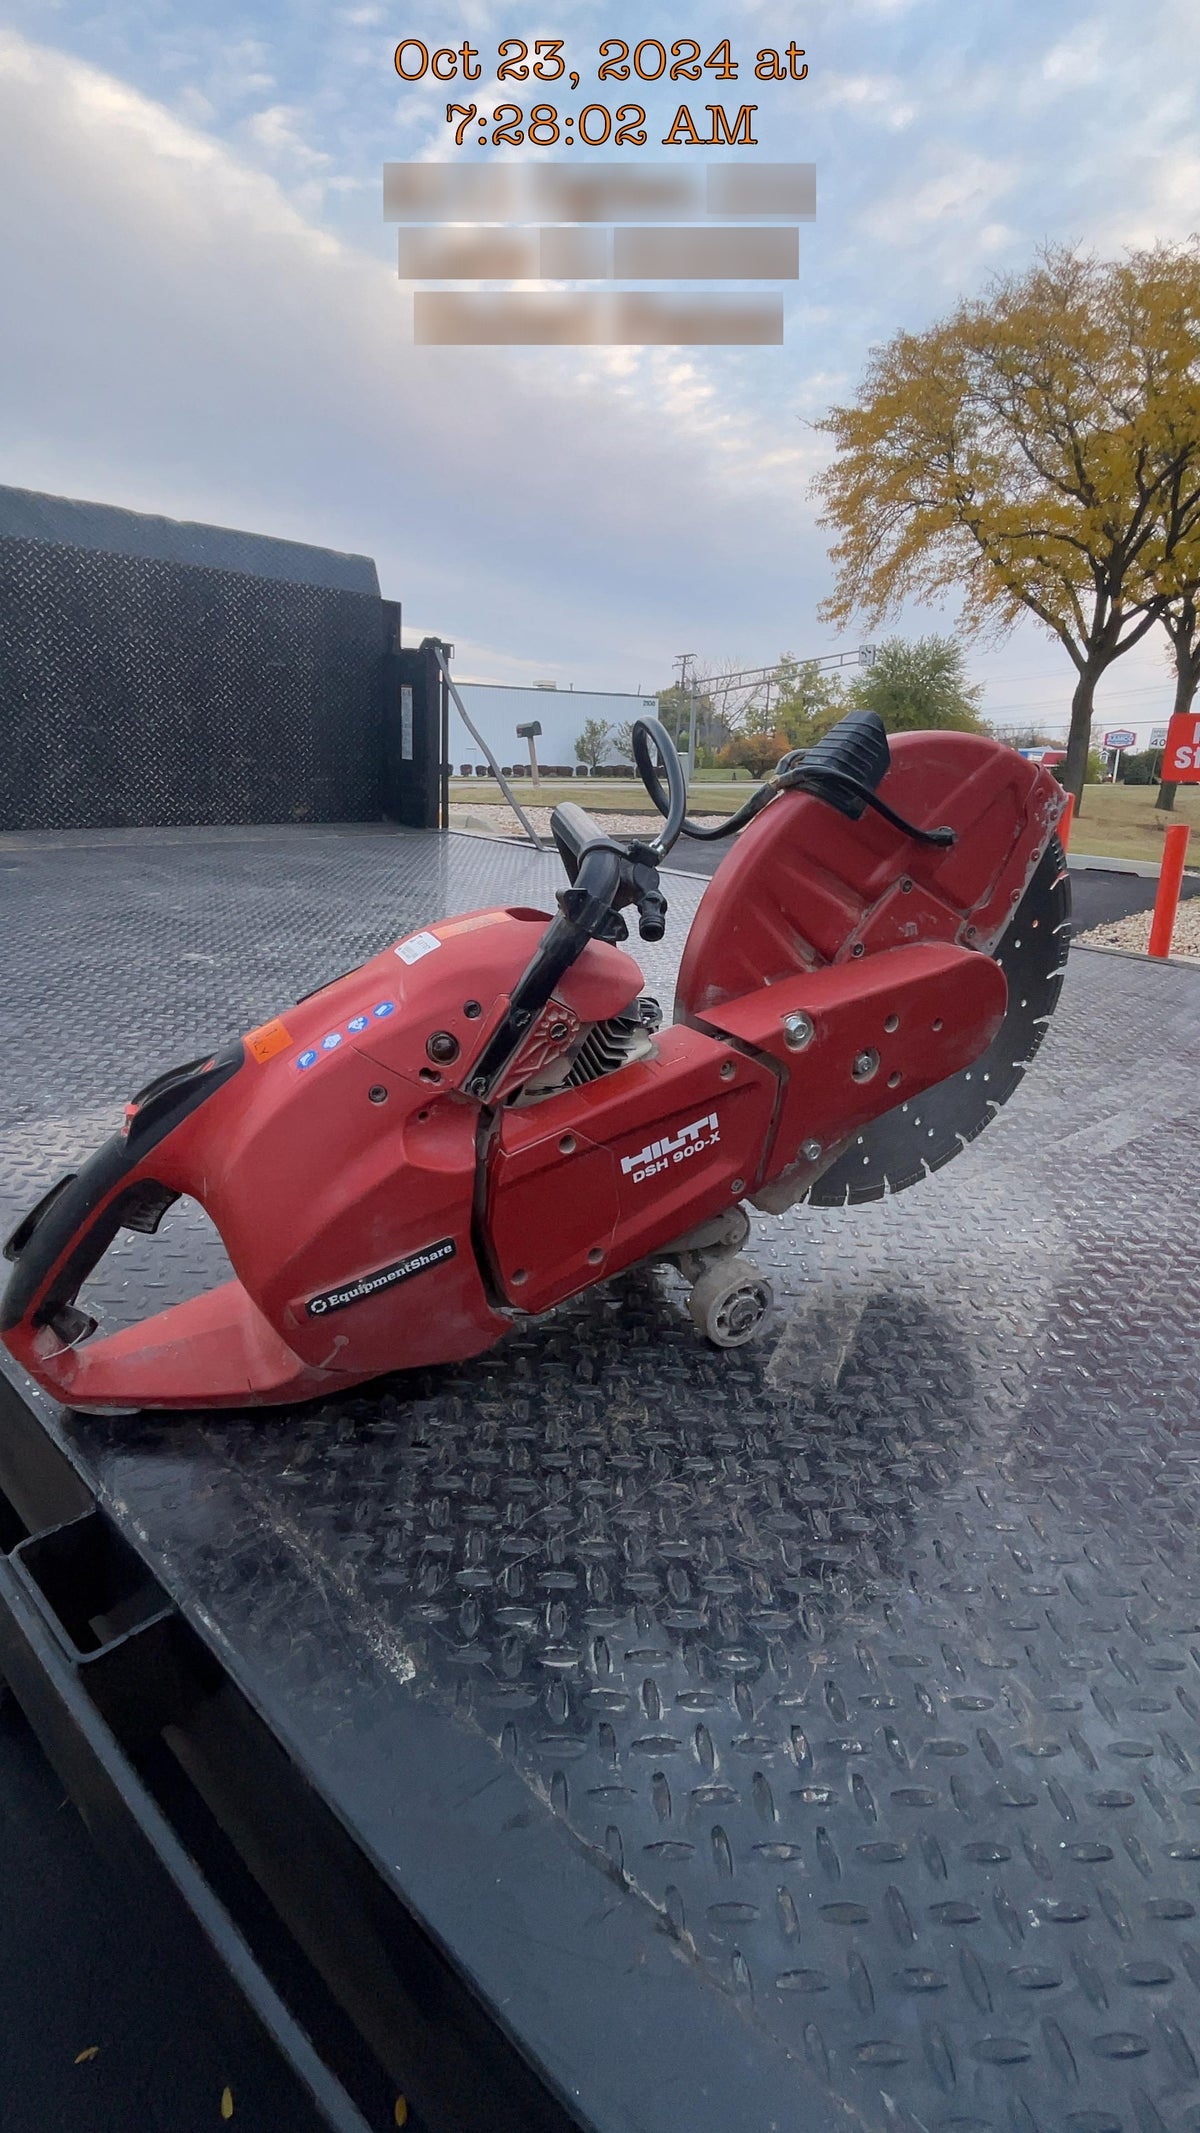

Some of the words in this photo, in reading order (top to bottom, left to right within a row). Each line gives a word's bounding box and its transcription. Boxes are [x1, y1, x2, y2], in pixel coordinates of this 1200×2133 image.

[1151, 738, 1167, 747] 40
[621, 1112, 719, 1175] HILTI
[632, 1159, 669, 1184] DSH
[672, 1131, 721, 1163] 900-X
[327, 1244, 453, 1307] EquipmentShare
